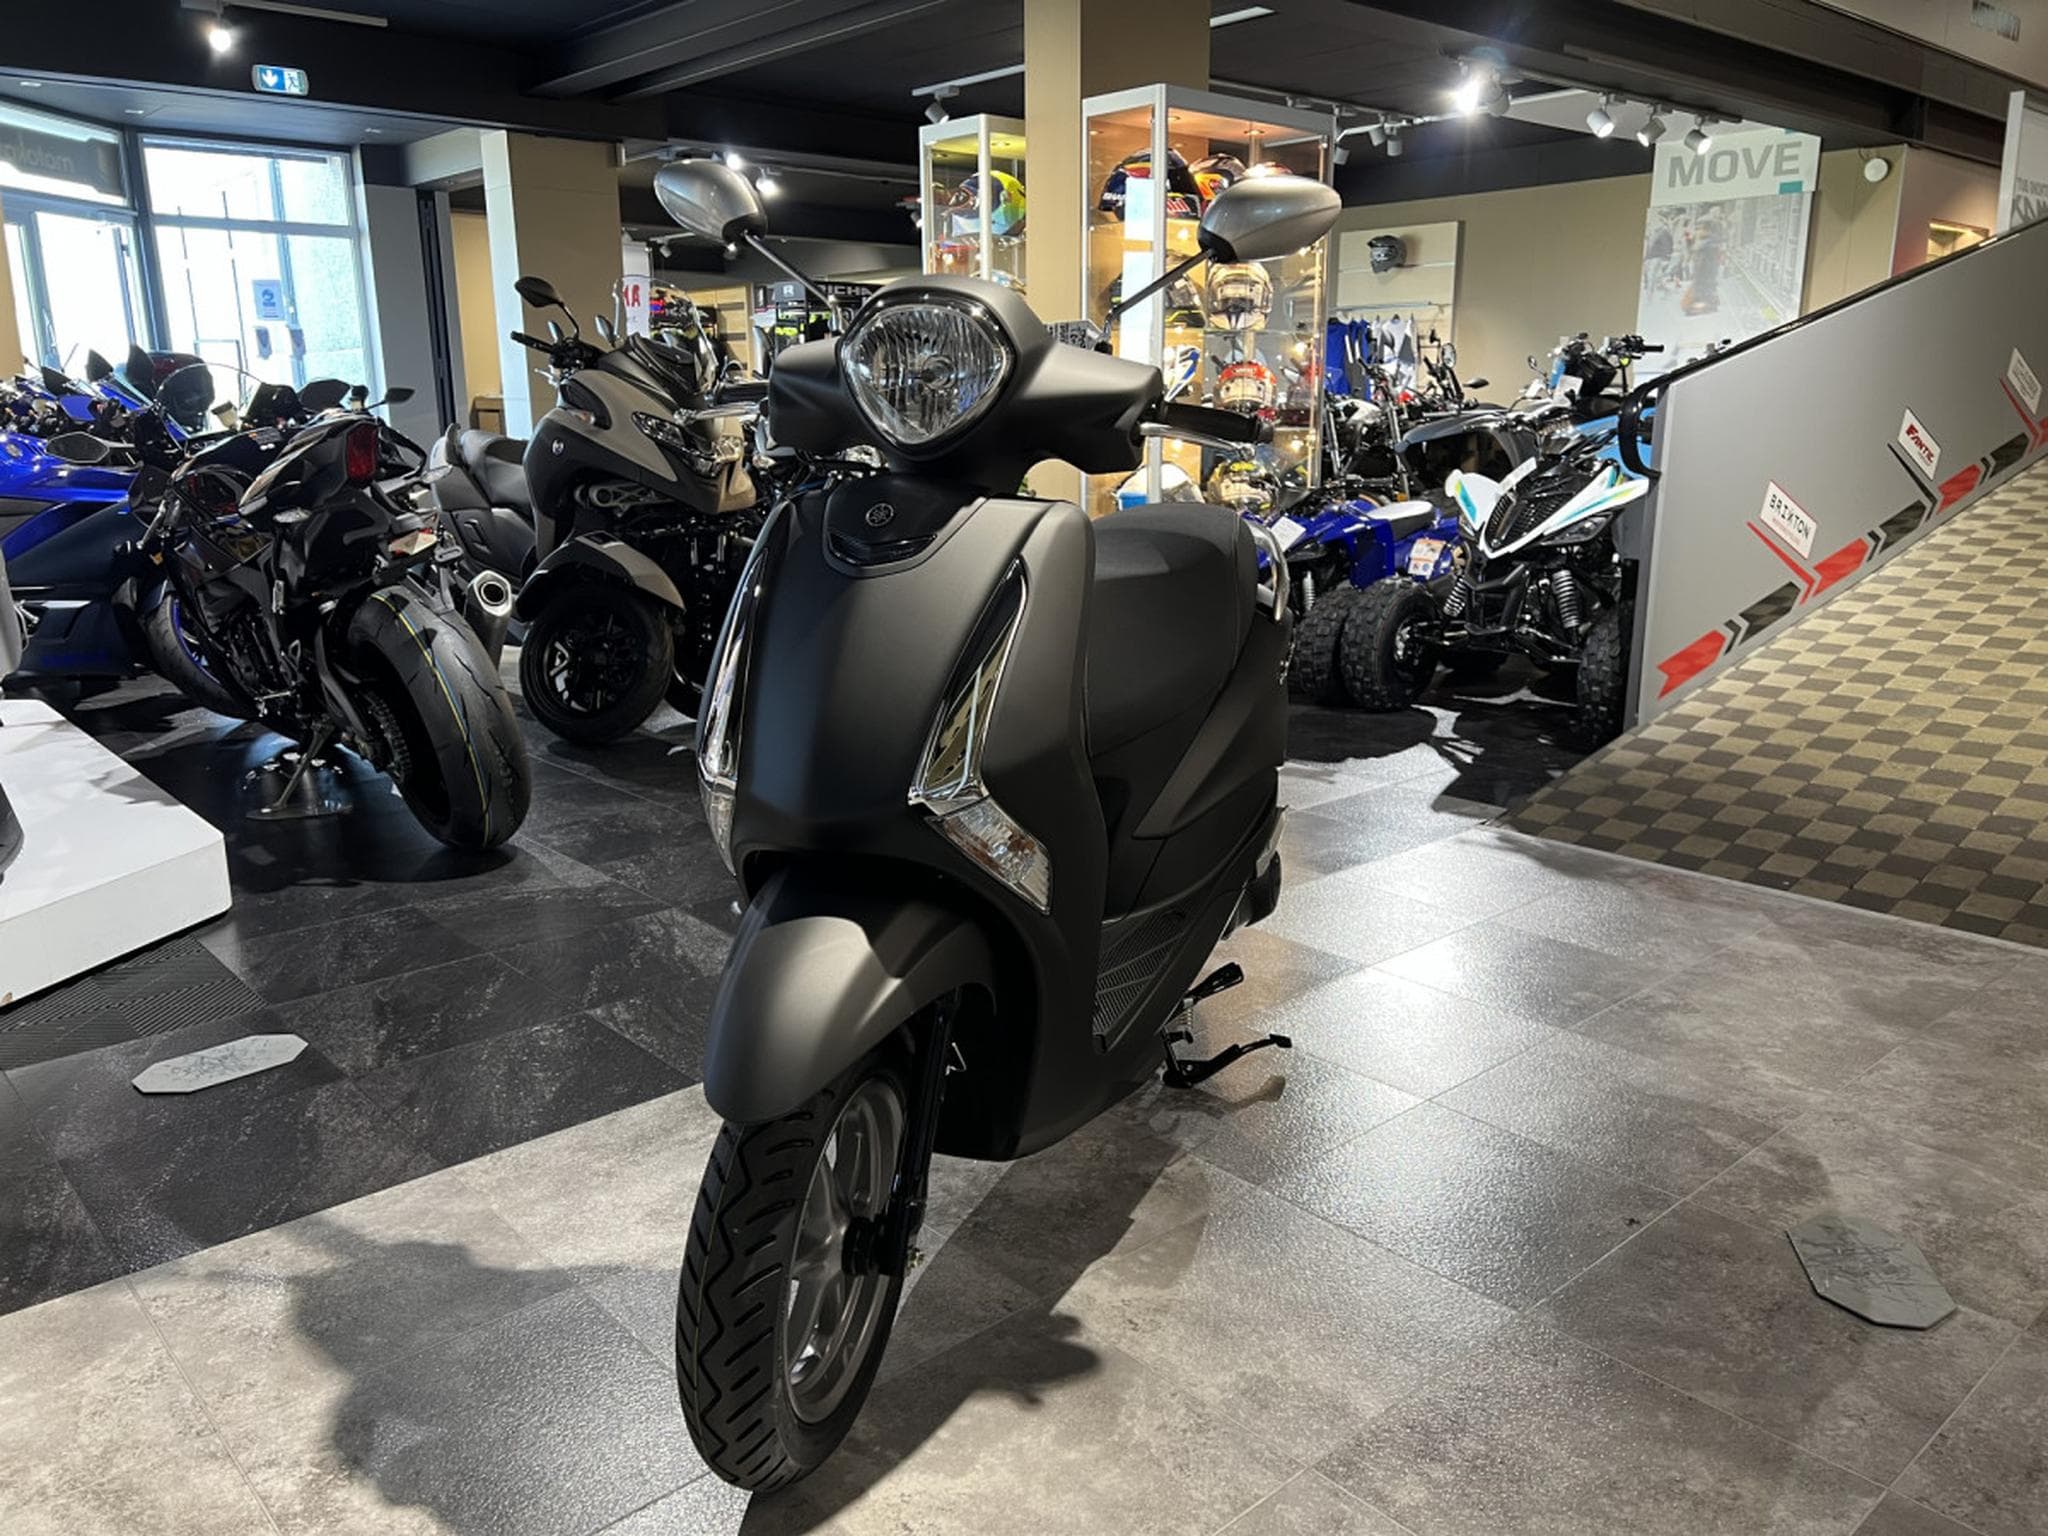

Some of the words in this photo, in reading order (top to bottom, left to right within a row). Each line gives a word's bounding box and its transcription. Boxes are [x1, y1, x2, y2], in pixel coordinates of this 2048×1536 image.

[1668, 141, 1803, 188] MOVE
[1905, 423, 1935, 464] FANTIC
[1769, 493, 1810, 540] BRIXTON
